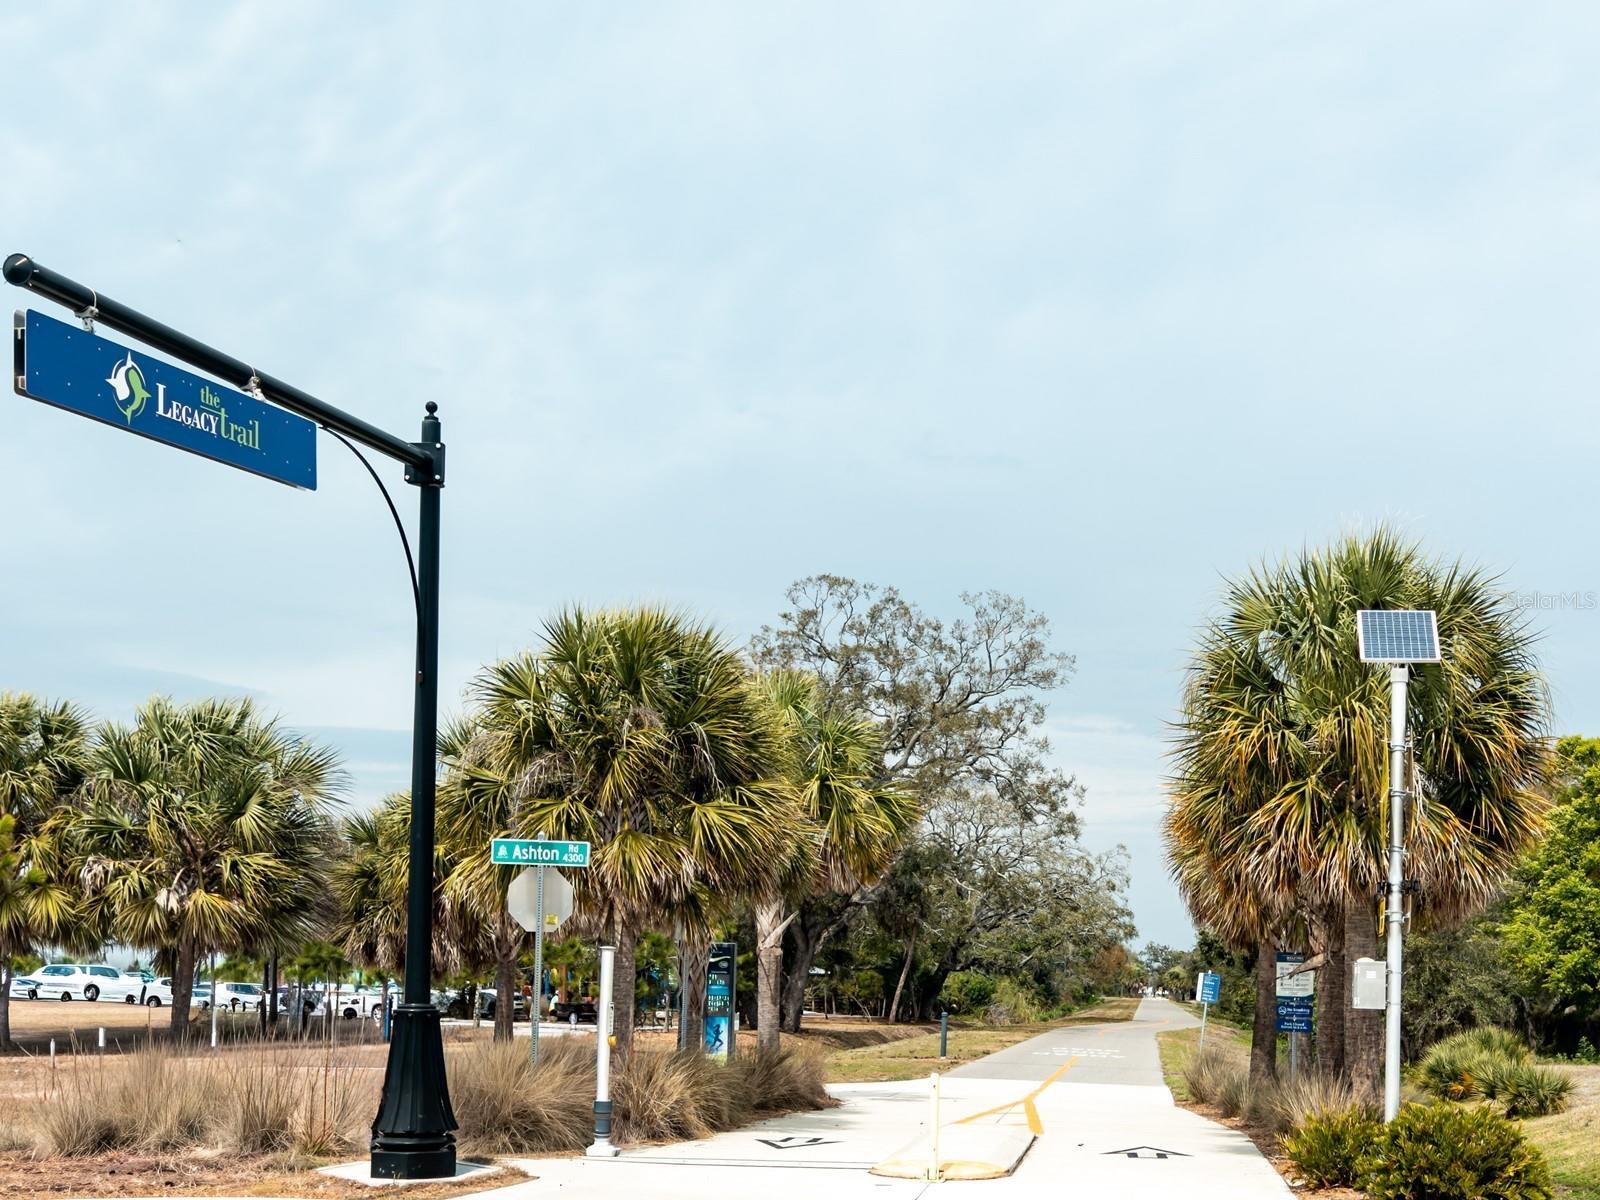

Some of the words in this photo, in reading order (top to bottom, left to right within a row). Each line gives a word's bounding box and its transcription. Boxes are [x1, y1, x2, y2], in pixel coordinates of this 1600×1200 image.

[201, 386, 220, 408] the
[156, 383, 219, 434] LEGACY
[220, 408, 260, 449] trail
[513, 844, 559, 861] Ashton
[568, 844, 580, 854] Rd
[562, 853, 584, 863] 4300
